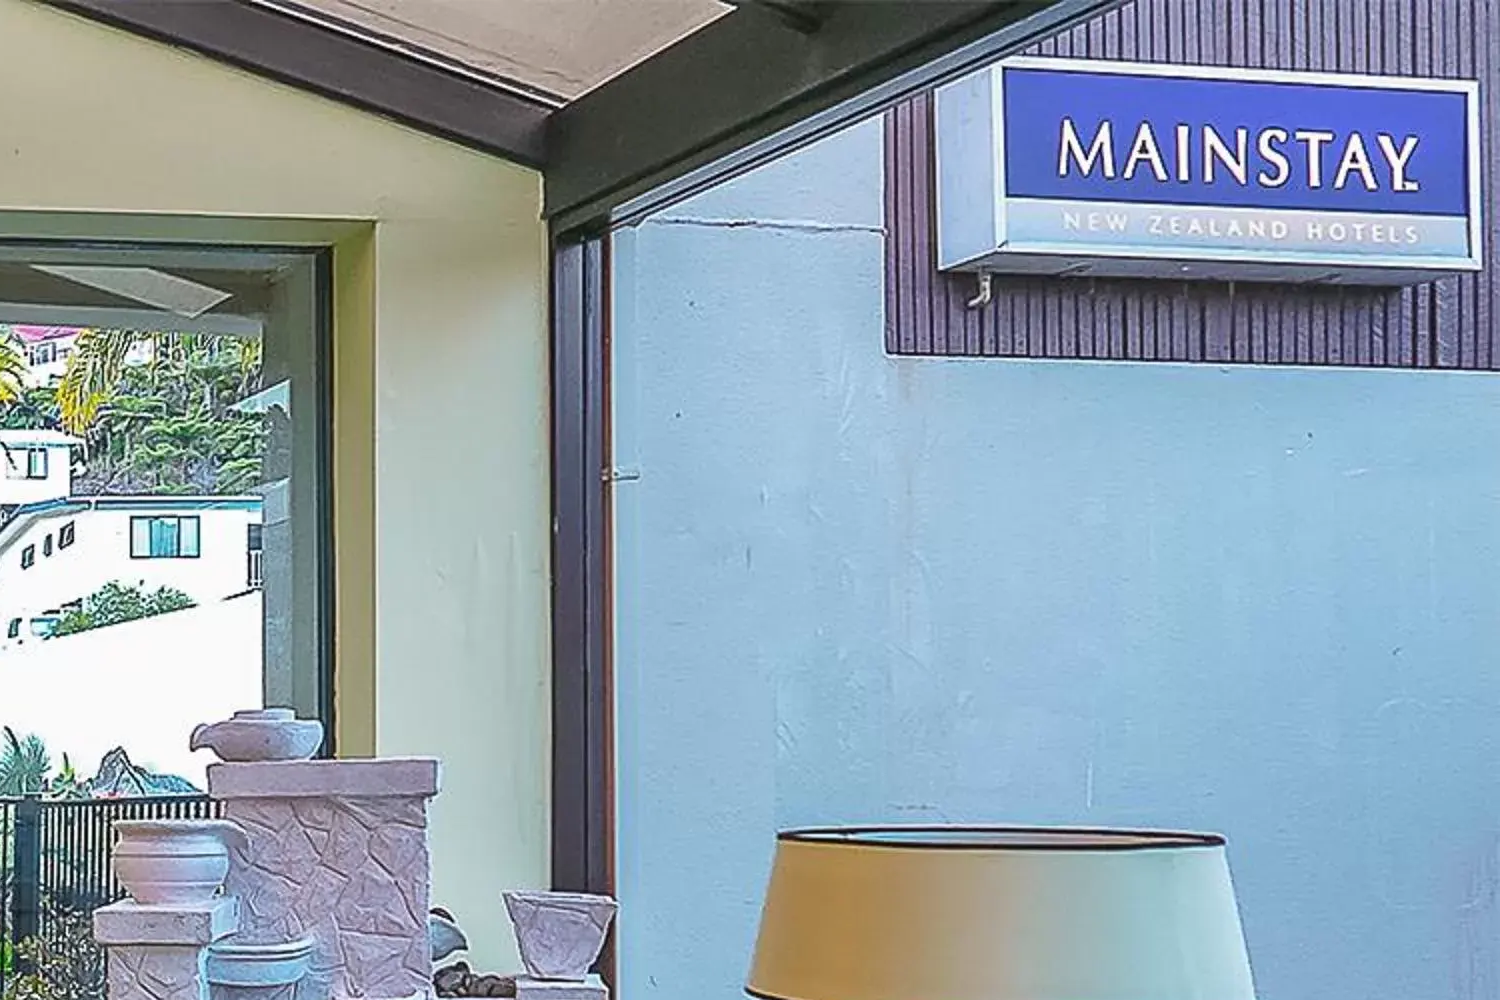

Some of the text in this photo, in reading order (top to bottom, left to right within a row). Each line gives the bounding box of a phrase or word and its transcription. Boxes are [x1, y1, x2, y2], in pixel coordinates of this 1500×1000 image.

[1062, 210, 1419, 244] NEW ZEALAND HOTELS
